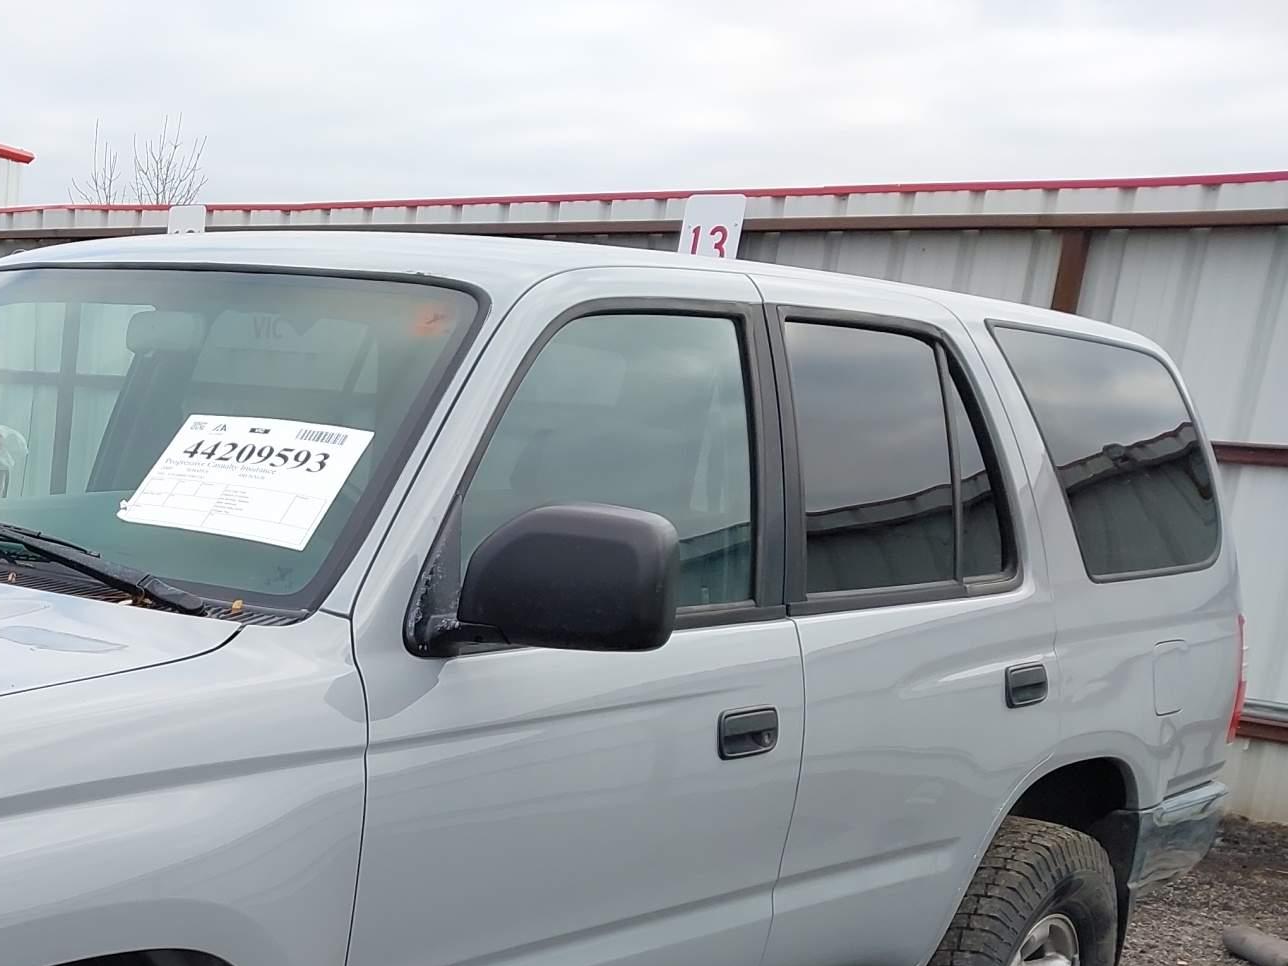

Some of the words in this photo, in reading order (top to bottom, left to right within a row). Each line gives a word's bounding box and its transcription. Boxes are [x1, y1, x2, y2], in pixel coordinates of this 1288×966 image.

[691, 225, 728, 258] 13
[183, 440, 330, 473] 44209593
[207, 461, 239, 472] Casualty
